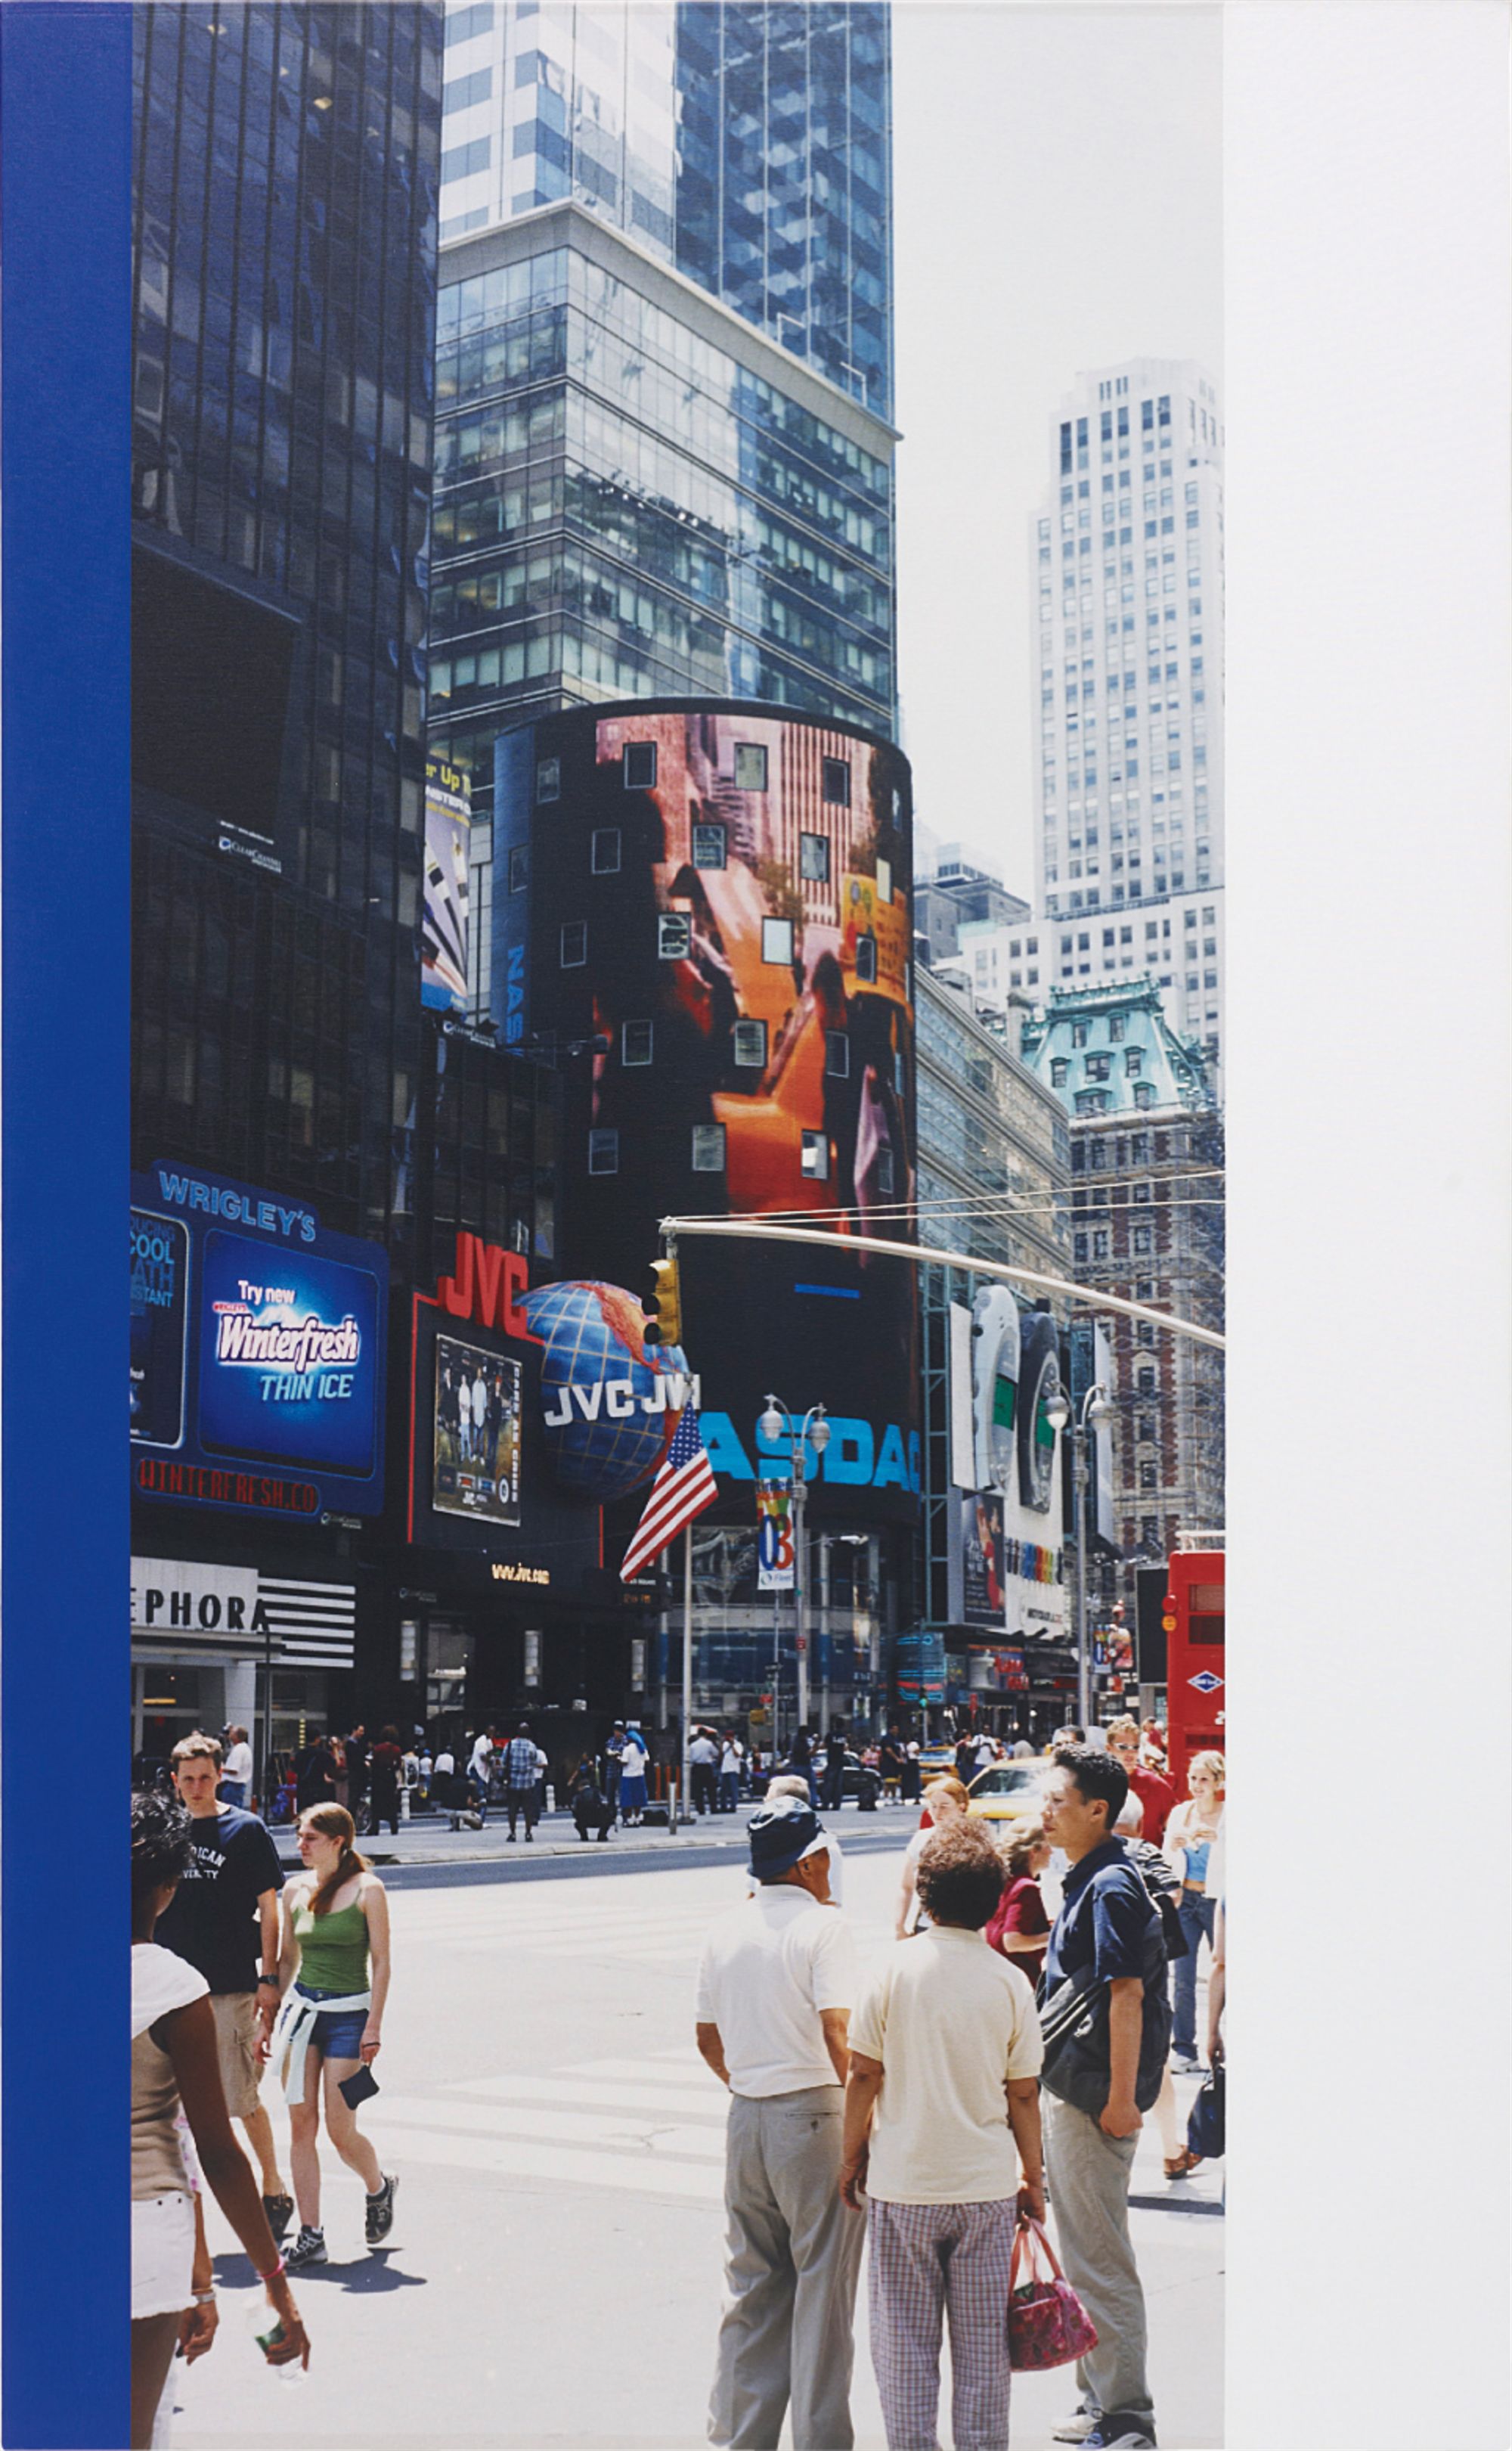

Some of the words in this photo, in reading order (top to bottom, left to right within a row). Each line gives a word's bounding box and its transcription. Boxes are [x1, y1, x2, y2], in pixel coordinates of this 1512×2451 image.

[441, 765, 460, 792] Up
[159, 1170, 316, 1243] WRIGLEY'S
[238, 1280, 263, 1305] Try
[265, 1288, 296, 1304] new
[437, 1230, 529, 1338] JVC
[219, 1314, 358, 1373] Winterfresh
[261, 1375, 314, 1401] THIN
[318, 1374, 354, 1398] ICE
[544, 1379, 635, 1427] JVC
[139, 1457, 315, 1512] WINTERFRESH.CO
[759, 1513, 795, 1571] 03
